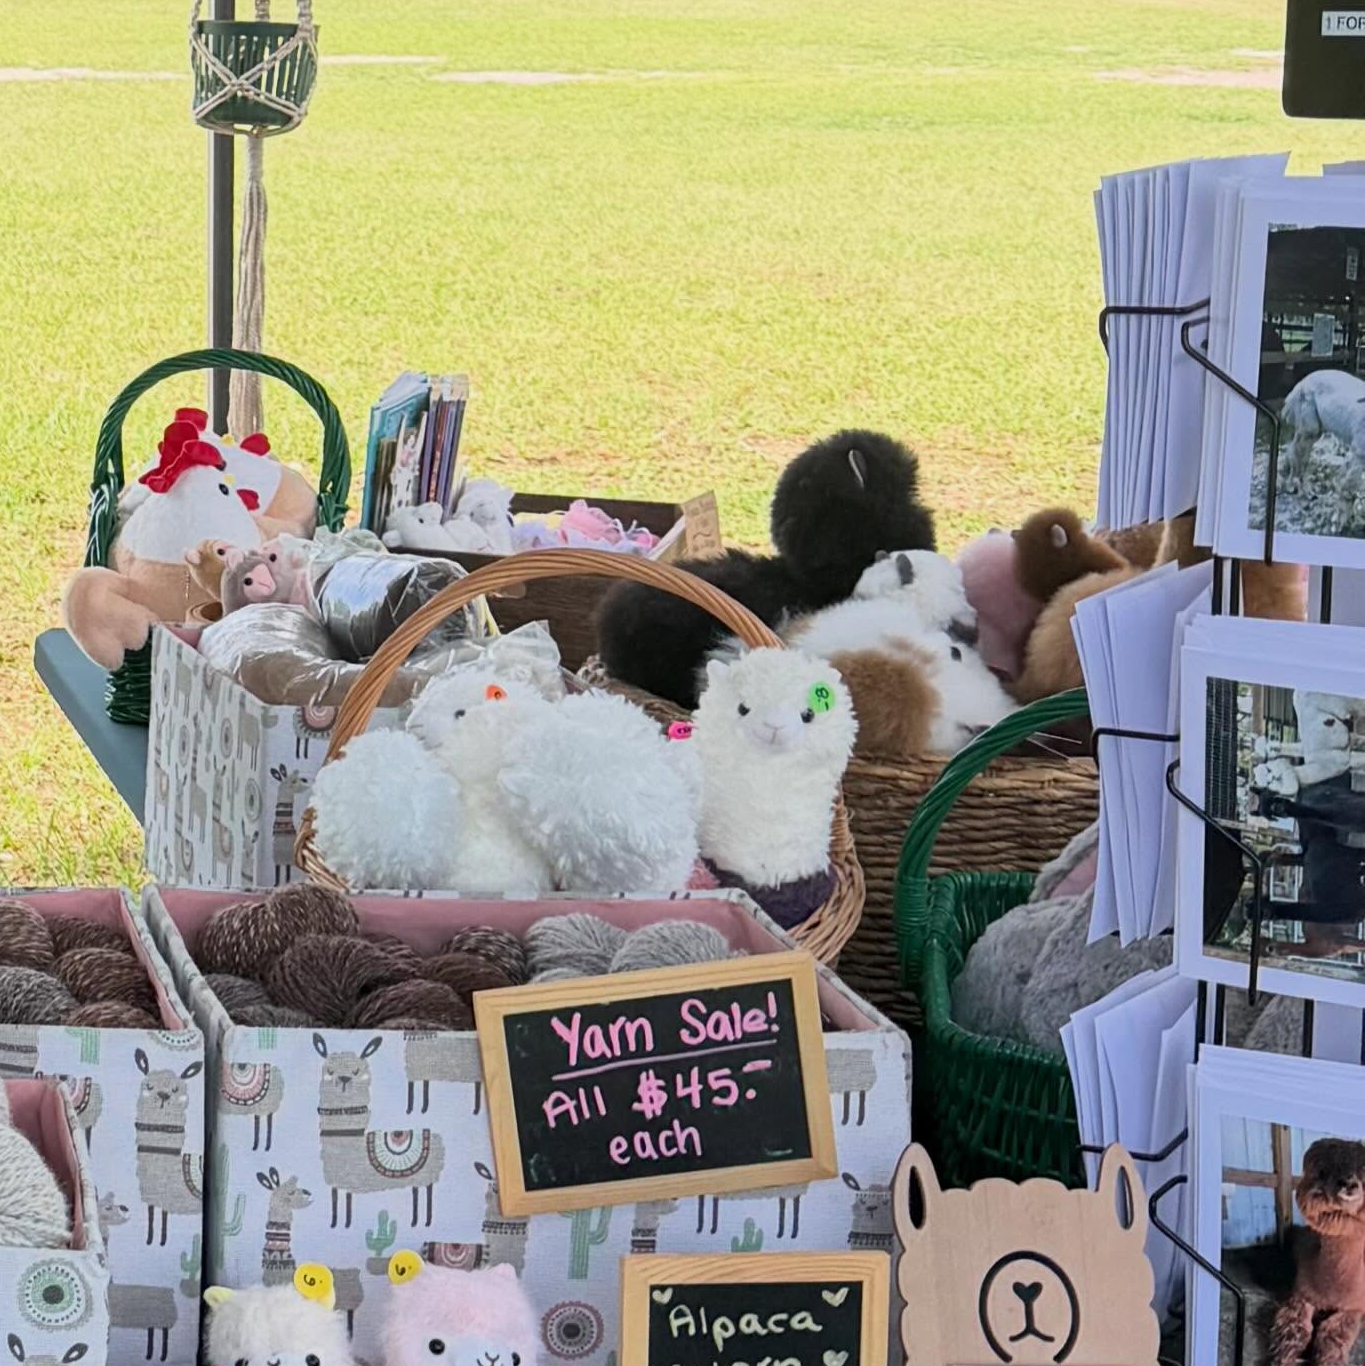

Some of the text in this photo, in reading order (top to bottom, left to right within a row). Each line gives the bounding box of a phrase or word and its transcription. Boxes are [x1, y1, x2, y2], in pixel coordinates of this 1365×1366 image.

[550, 991, 781, 1067] Yarn Sale!
[542, 1085, 608, 1129] All
[609, 1118, 703, 1165] each
[669, 1304, 823, 1353] Alpaca
